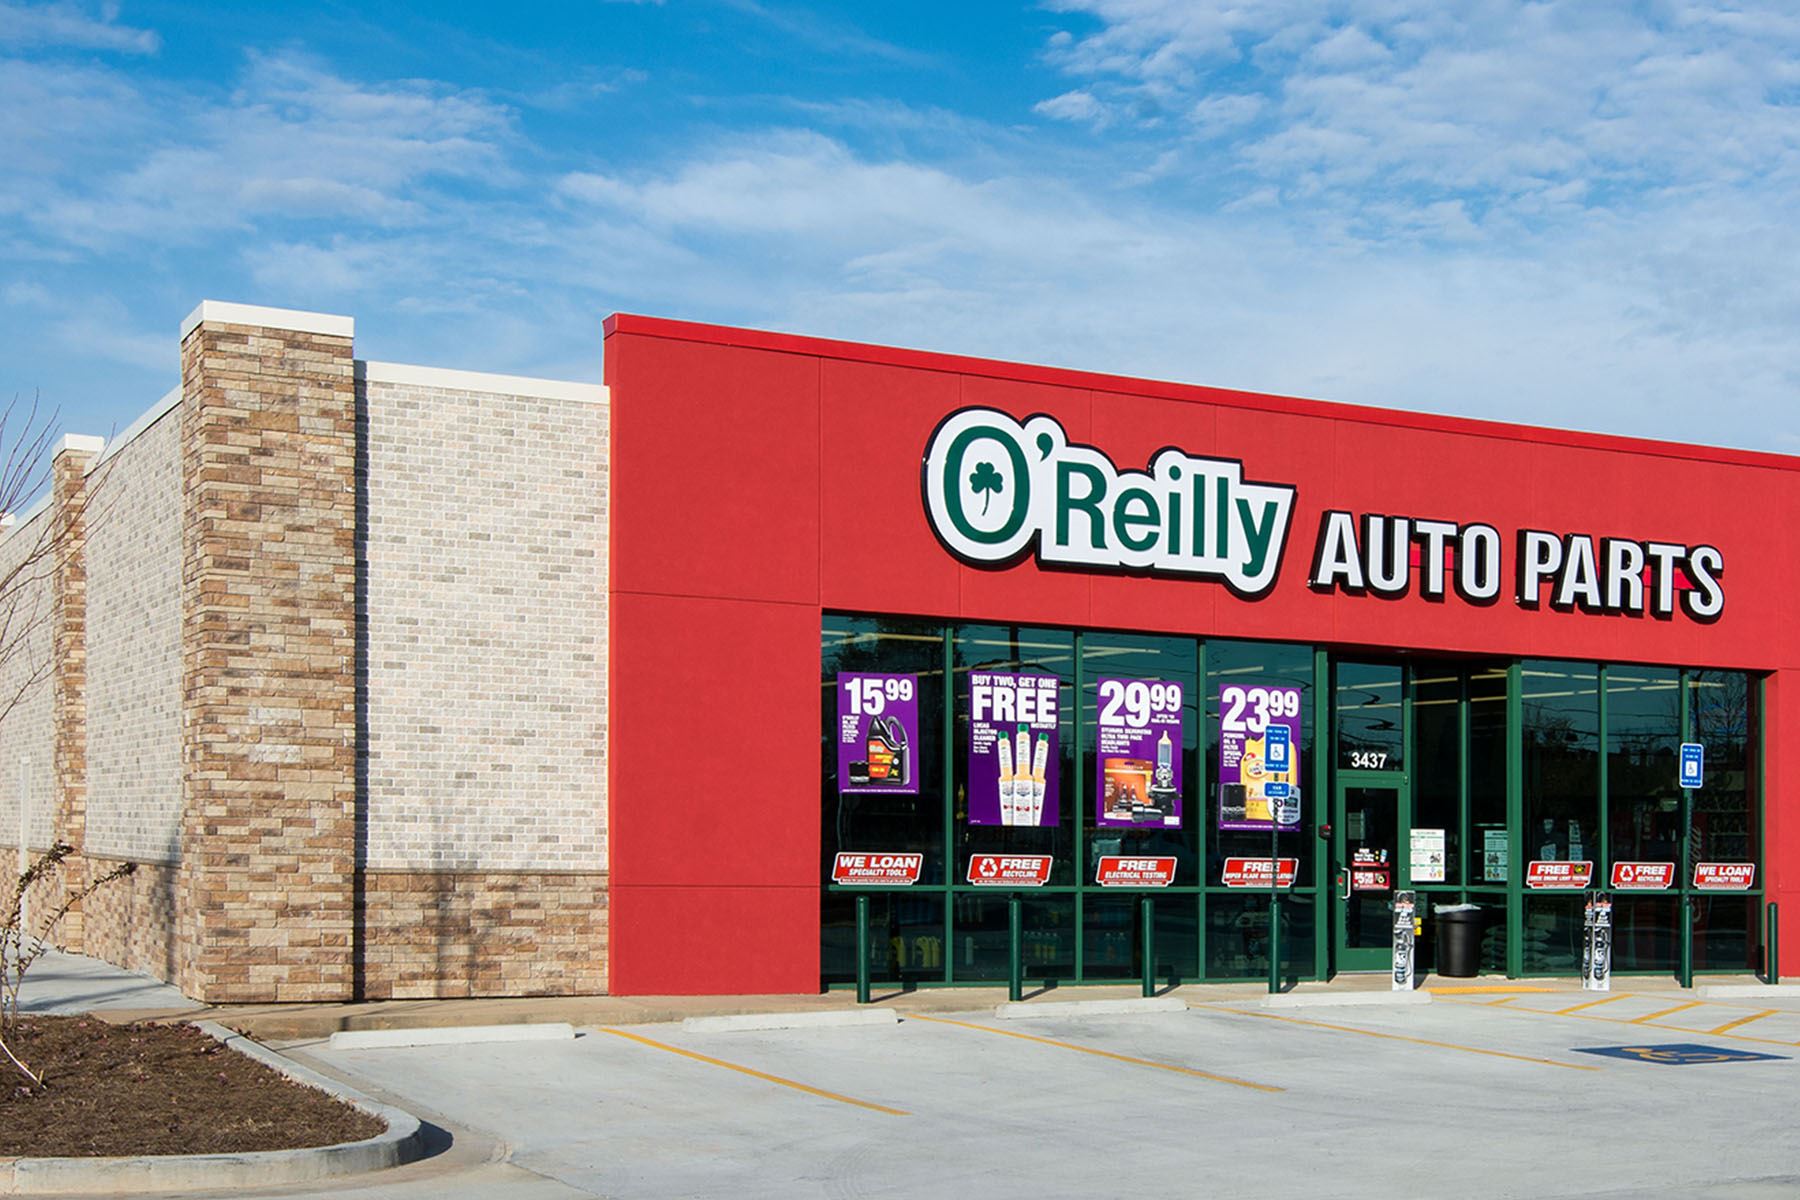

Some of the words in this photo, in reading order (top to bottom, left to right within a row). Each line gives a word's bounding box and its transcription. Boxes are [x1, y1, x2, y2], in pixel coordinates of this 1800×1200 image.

[943, 425, 1279, 577] O'Reilly
[1314, 510, 1500, 601] AUTO
[1517, 529, 1724, 617] PARTS
[972, 675, 991, 686] BUY
[993, 675, 1017, 688] TWO,
[1019, 677, 1036, 687] GET
[1038, 678, 1057, 689] ONE
[972, 686, 1057, 723] FREE
[1351, 751, 1387, 769] 3437
[839, 856, 865, 868] WE
[870, 857, 917, 868] LOAN
[1000, 859, 1042, 870] FREE
[1117, 860, 1158, 870] FREE
[848, 868, 884, 876] SPECIALTY
[886, 869, 907, 877] TOOLS
[1537, 865, 1570, 875] FREE
[1636, 866, 1667, 876] FREE
[1699, 866, 1717, 876] WE
[1719, 866, 1751, 876] LOAN
